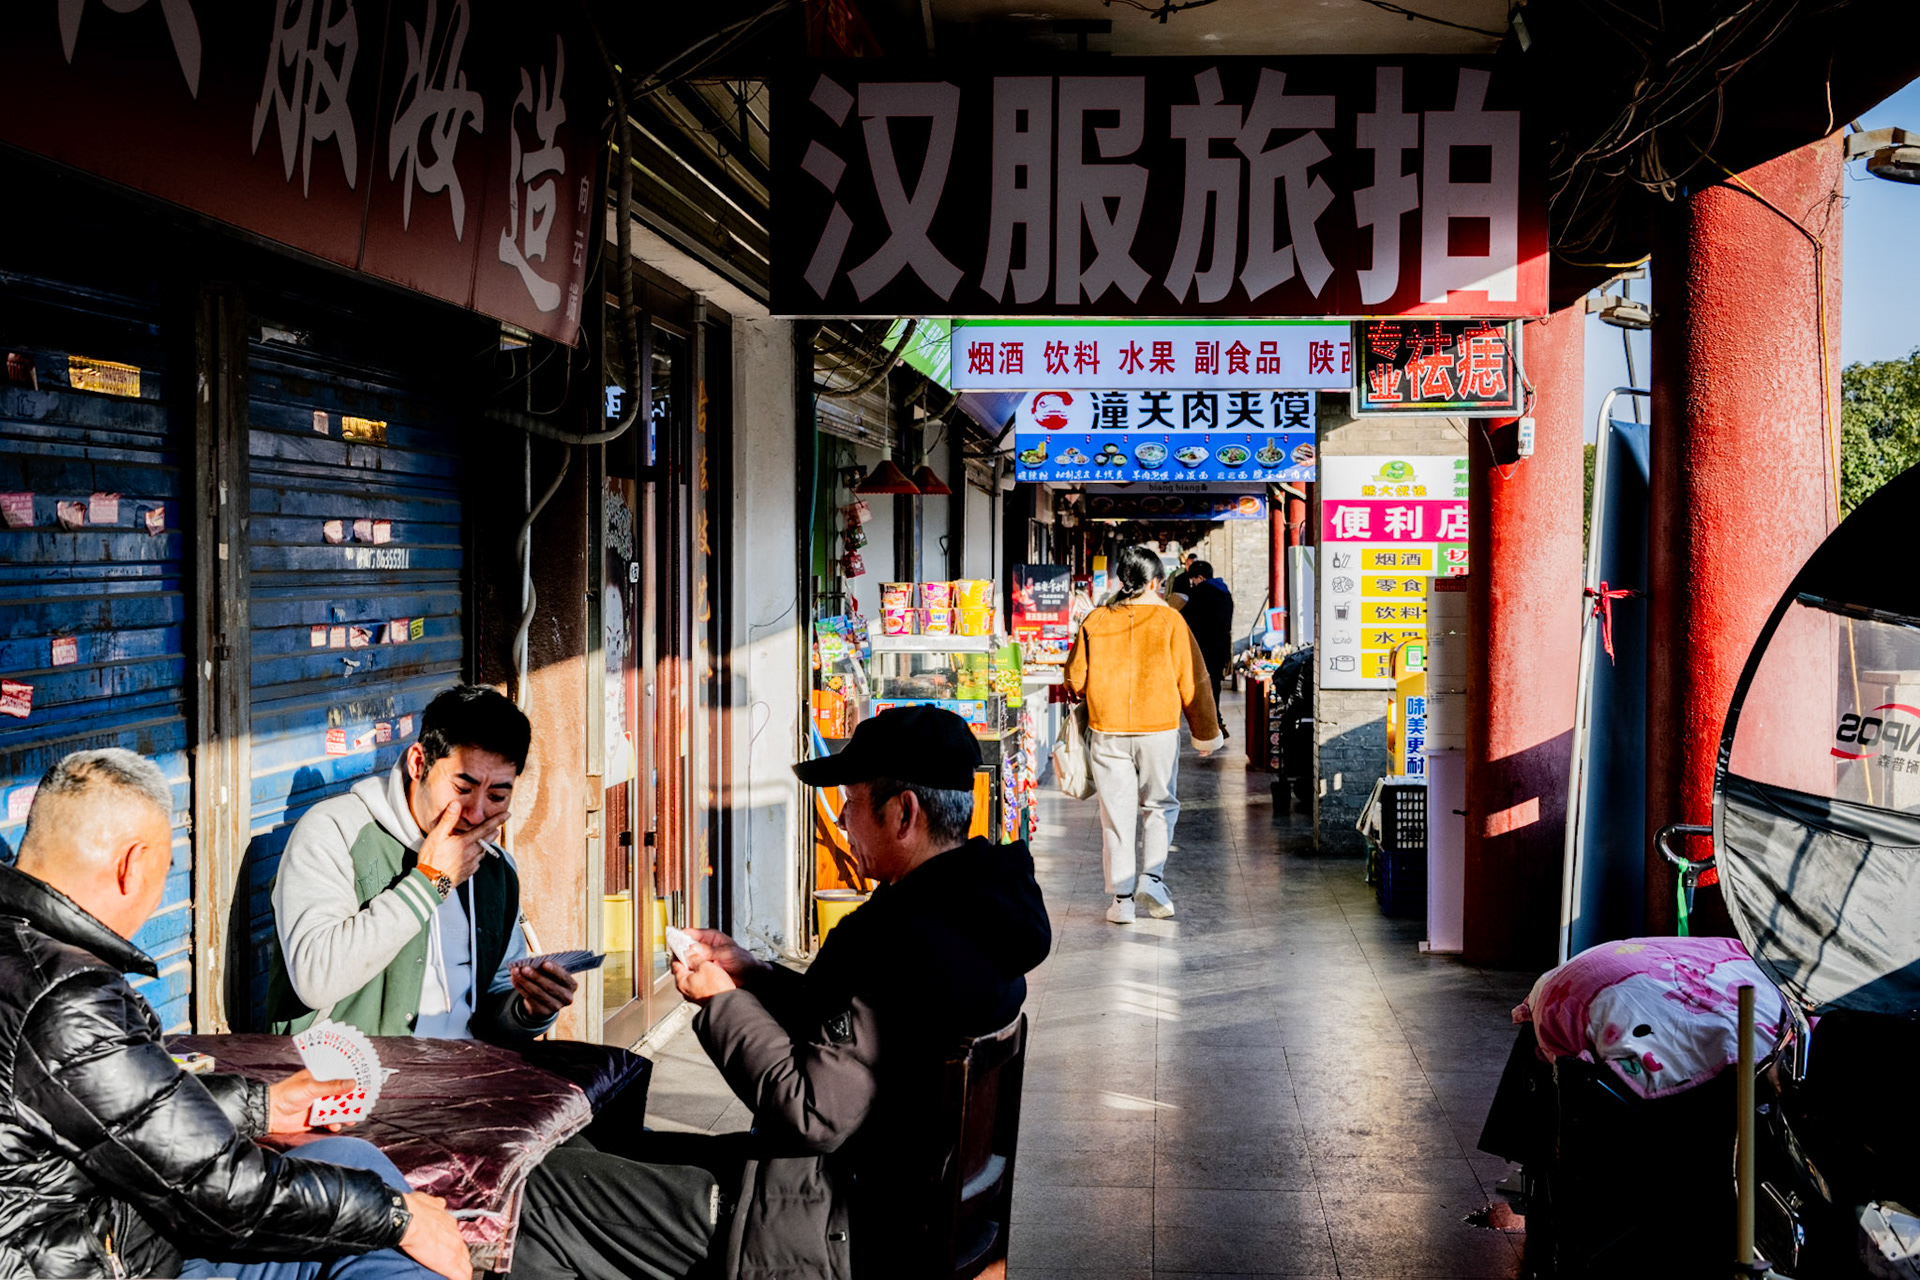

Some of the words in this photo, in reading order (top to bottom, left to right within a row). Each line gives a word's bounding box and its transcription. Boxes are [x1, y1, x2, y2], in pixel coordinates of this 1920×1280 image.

[58, 0, 567, 312] 服妆造
[801, 66, 1521, 304] 汉服旅拍
[967, 340, 1024, 376] 烟酒
[1043, 340, 1100, 376] 饮料
[1119, 340, 1176, 376] 水果
[1195, 340, 1281, 376] 副食品
[1367, 320, 1402, 402] 专业
[1404, 320, 1507, 402] 祛痣
[1090, 391, 1315, 429] 潼关肉夹馍
[1149, 484, 1173, 492] biang
[1331, 504, 1469, 540] 便利店
[1374, 552, 1422, 566] 烟酒
[1375, 578, 1422, 592] 零食
[1374, 605, 1422, 620] 饮料
[1406, 698, 1425, 779] 味美更耐
